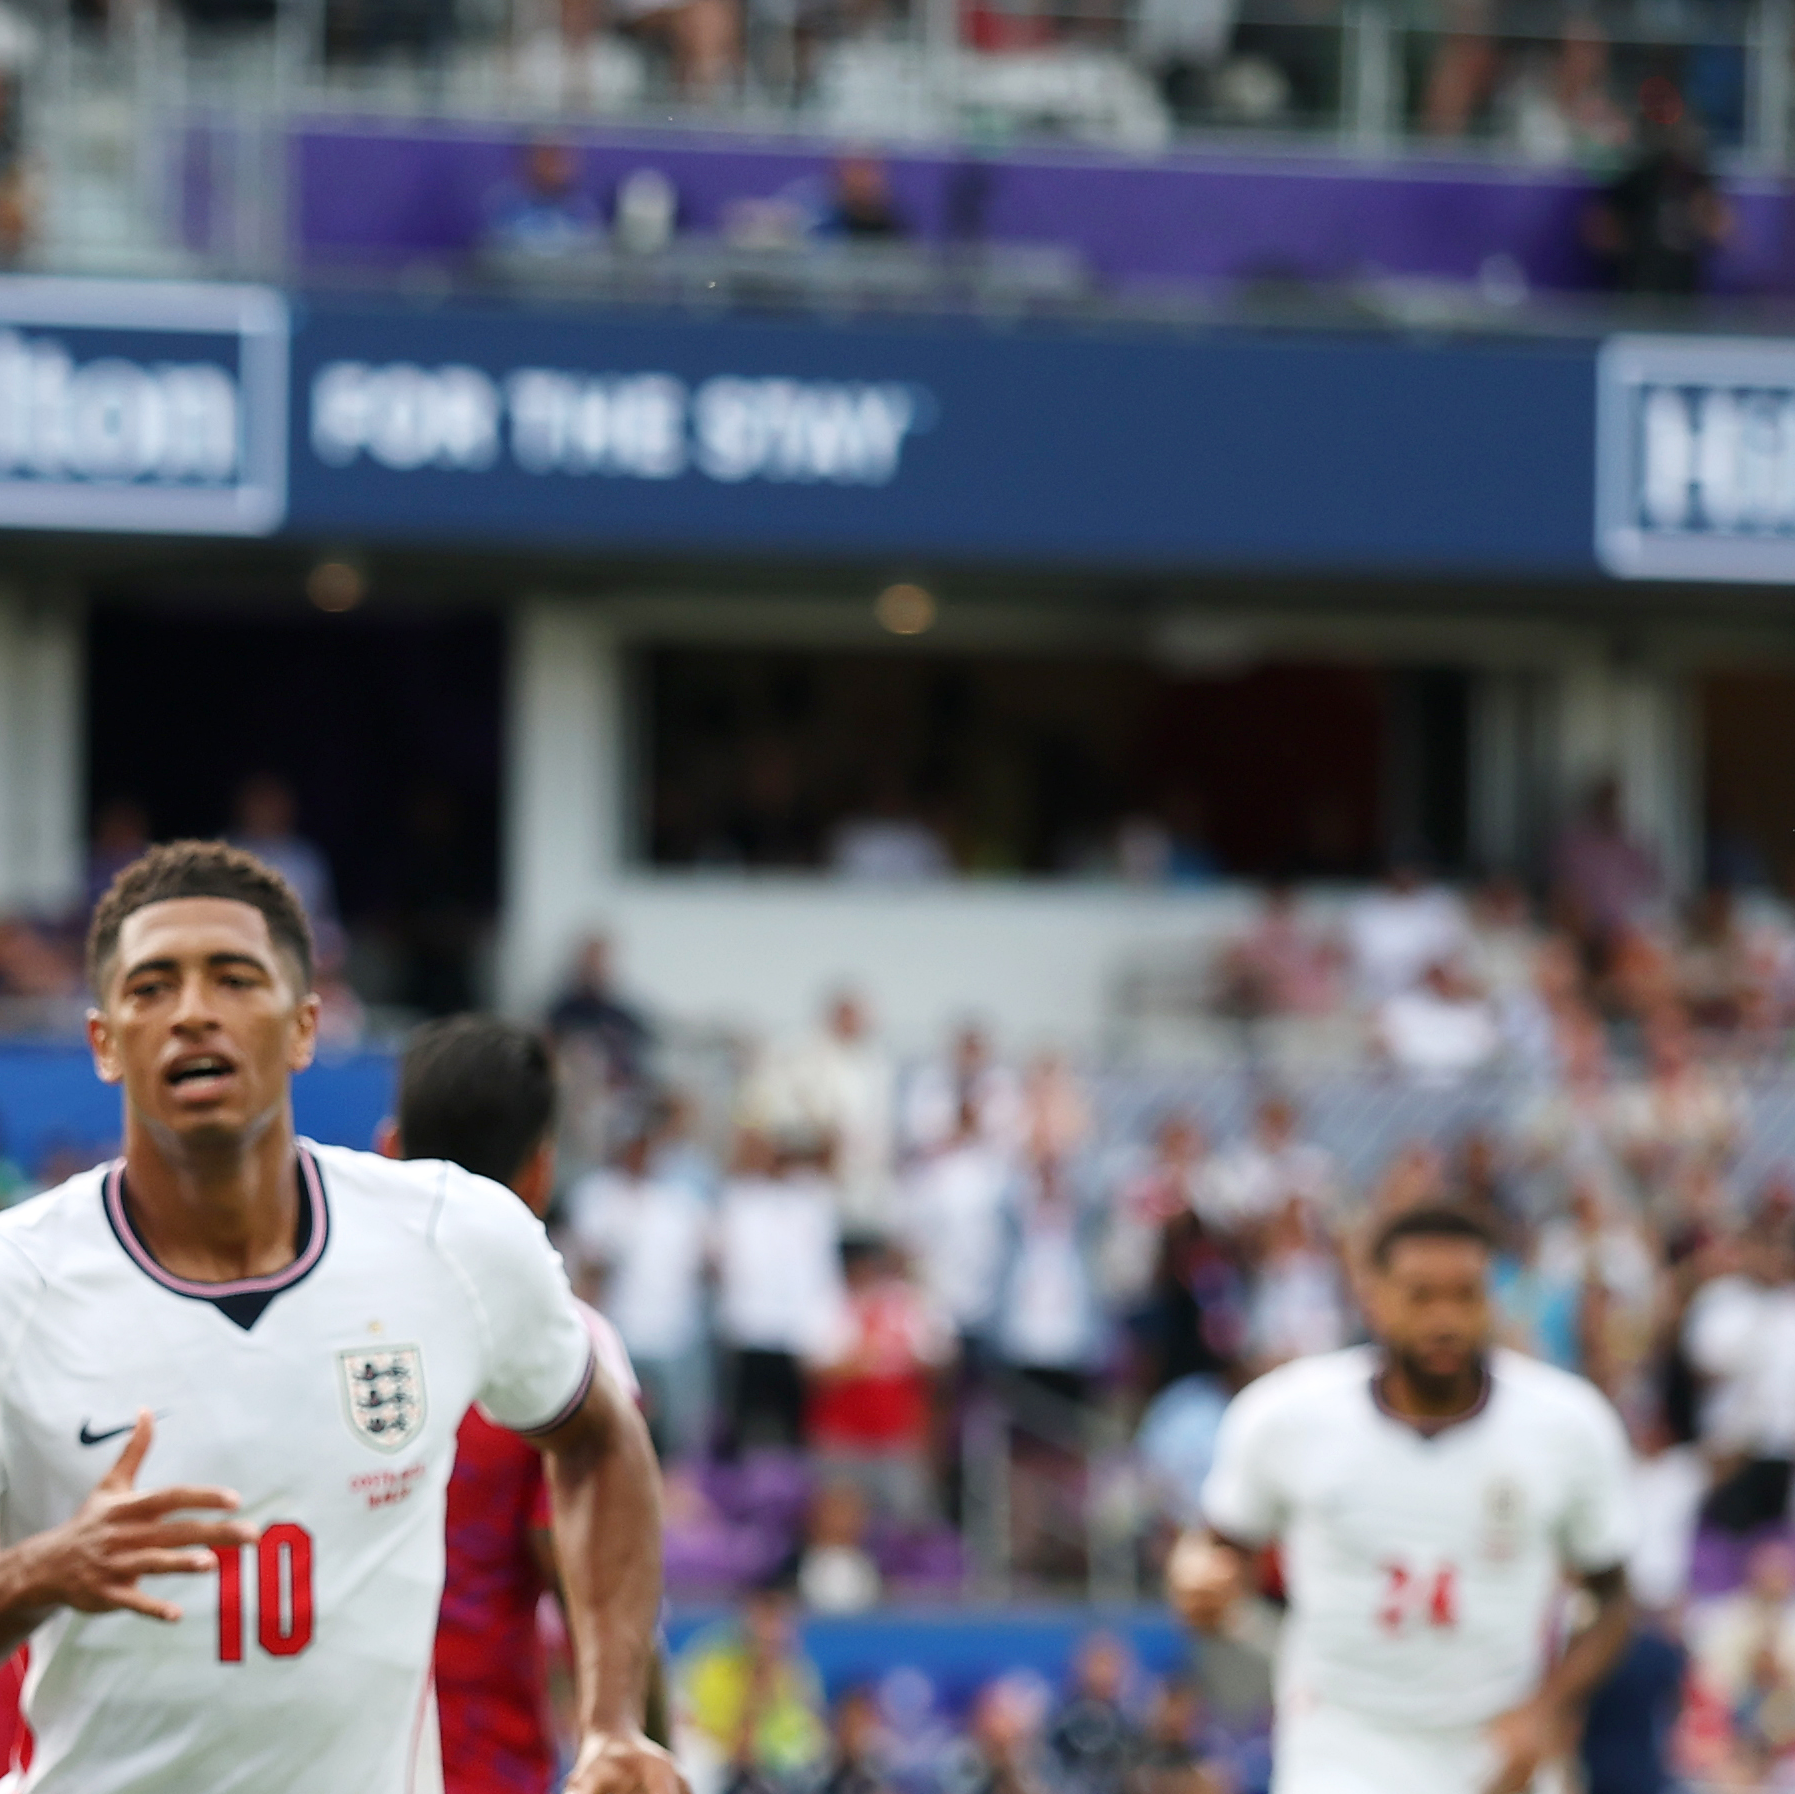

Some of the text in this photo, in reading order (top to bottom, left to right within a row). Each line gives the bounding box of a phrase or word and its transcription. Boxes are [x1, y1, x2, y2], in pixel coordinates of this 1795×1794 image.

[312, 362, 911, 486] FOR THE STAY
[1644, 388, 1795, 530] Hi
[210, 1522, 314, 1663] 10
